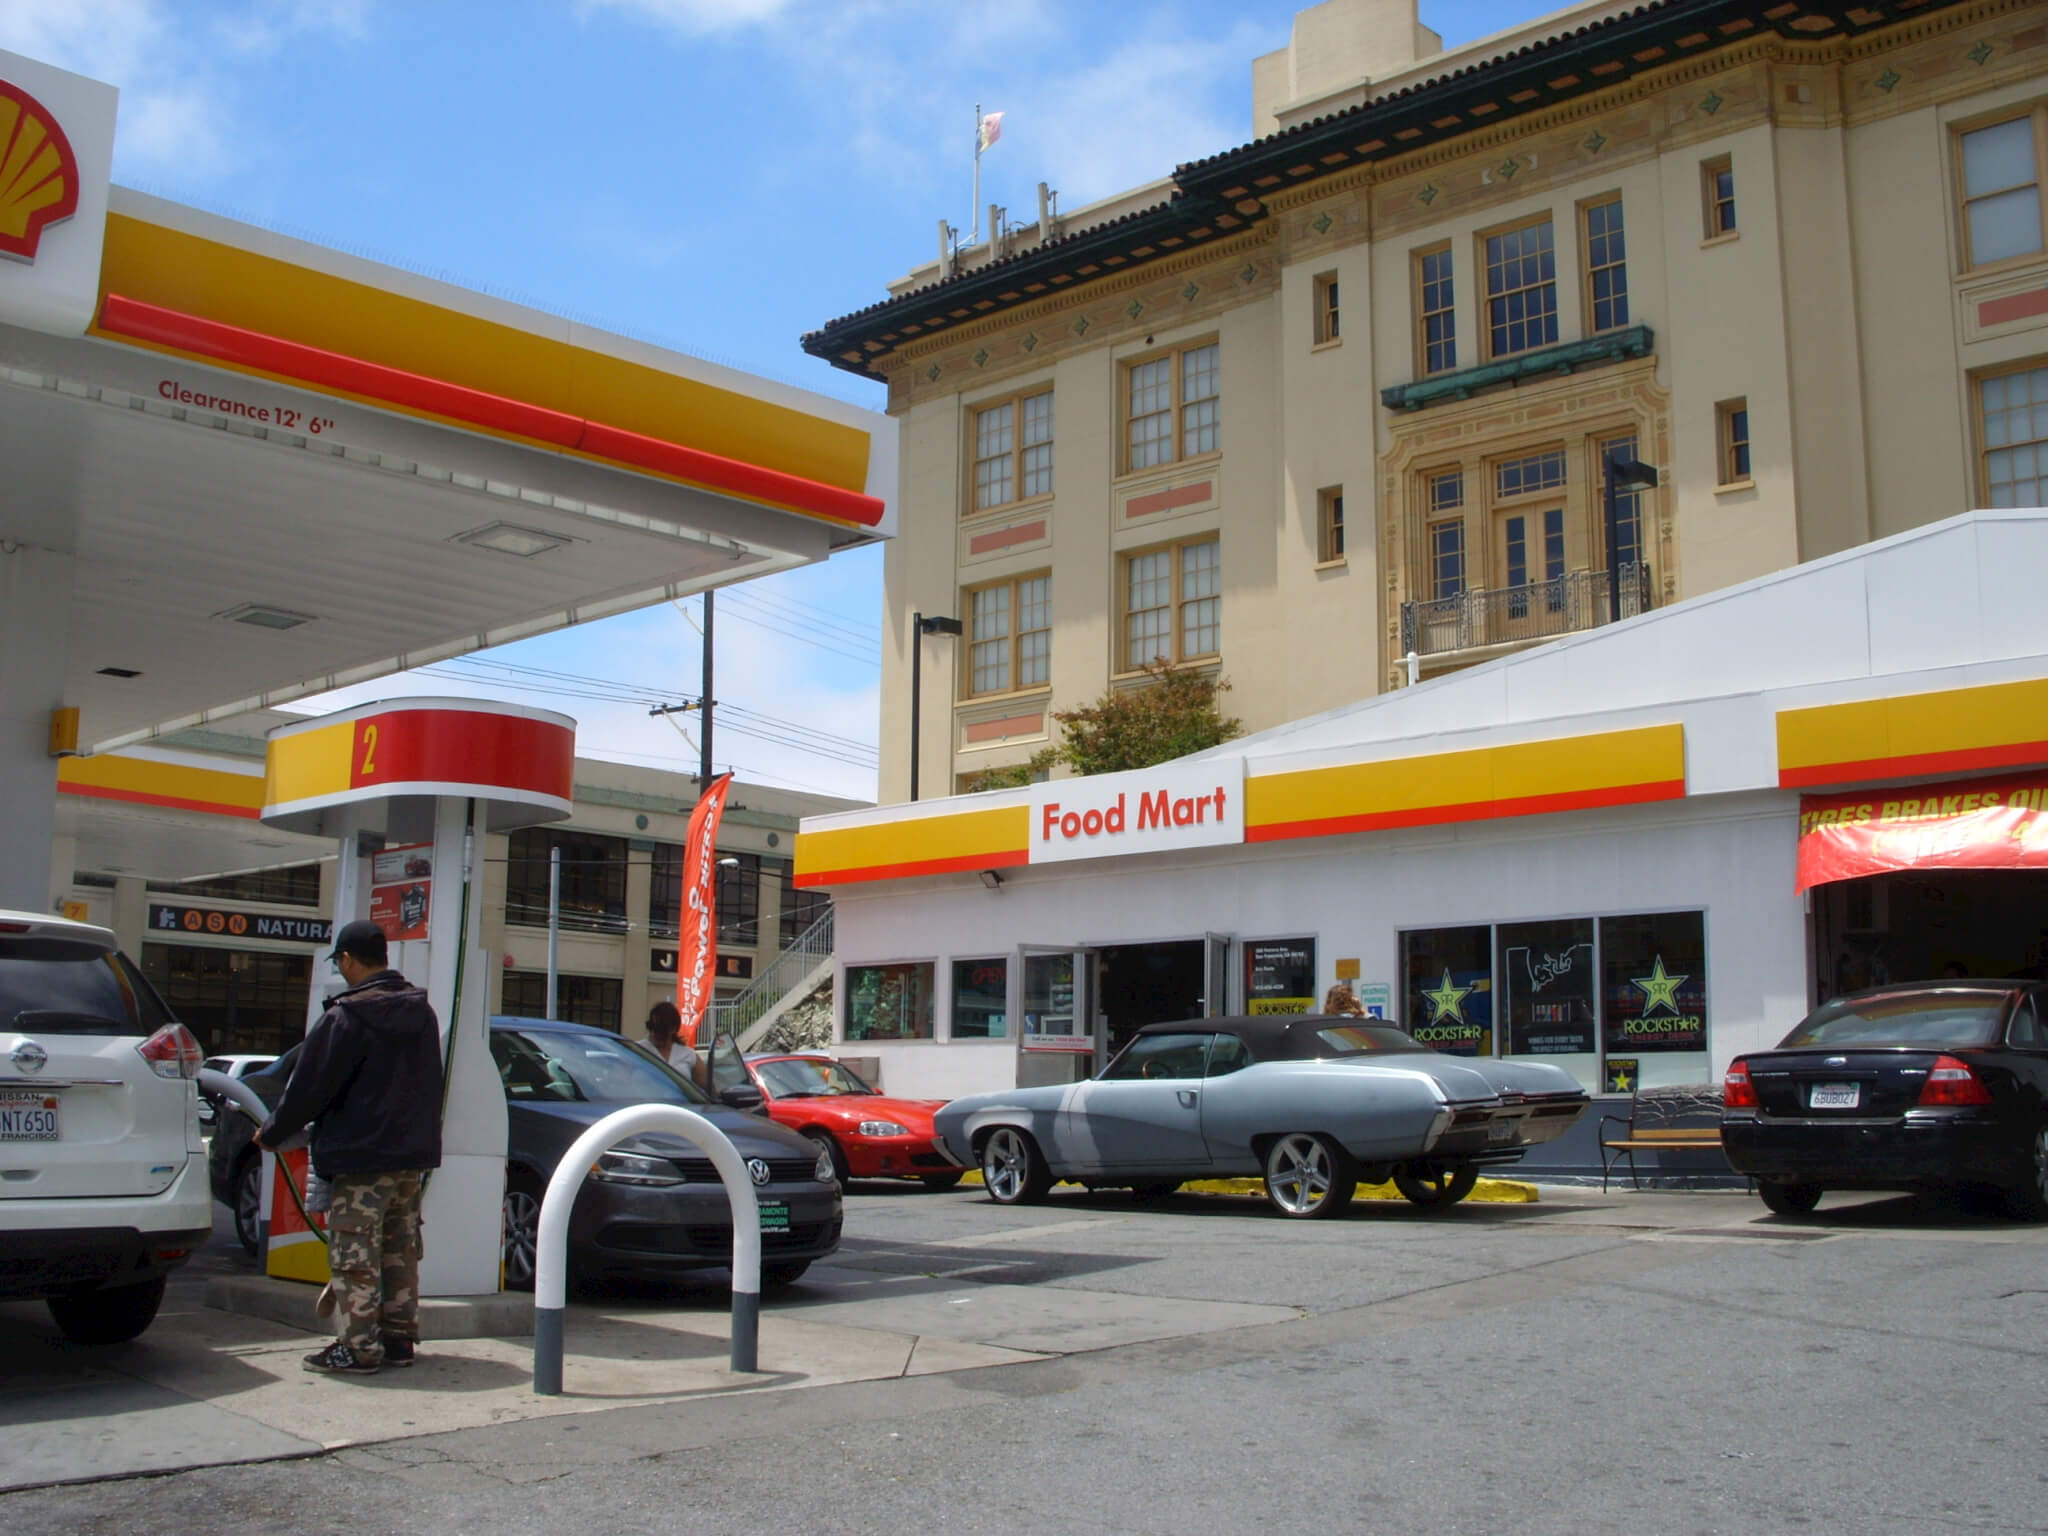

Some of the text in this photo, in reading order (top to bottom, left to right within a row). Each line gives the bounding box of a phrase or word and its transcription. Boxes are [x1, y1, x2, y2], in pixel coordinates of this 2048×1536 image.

[158, 380, 270, 422] Clearance
[361, 724, 377, 775] 2
[1043, 786, 1226, 841] Food Mart
[1800, 804, 1873, 838] TIRES
[1880, 792, 2001, 825] BRAKES
[680, 976, 691, 1026] Shell
[0, 1090, 40, 1101] ISSAN
[0, 1111, 55, 1132] NT650
